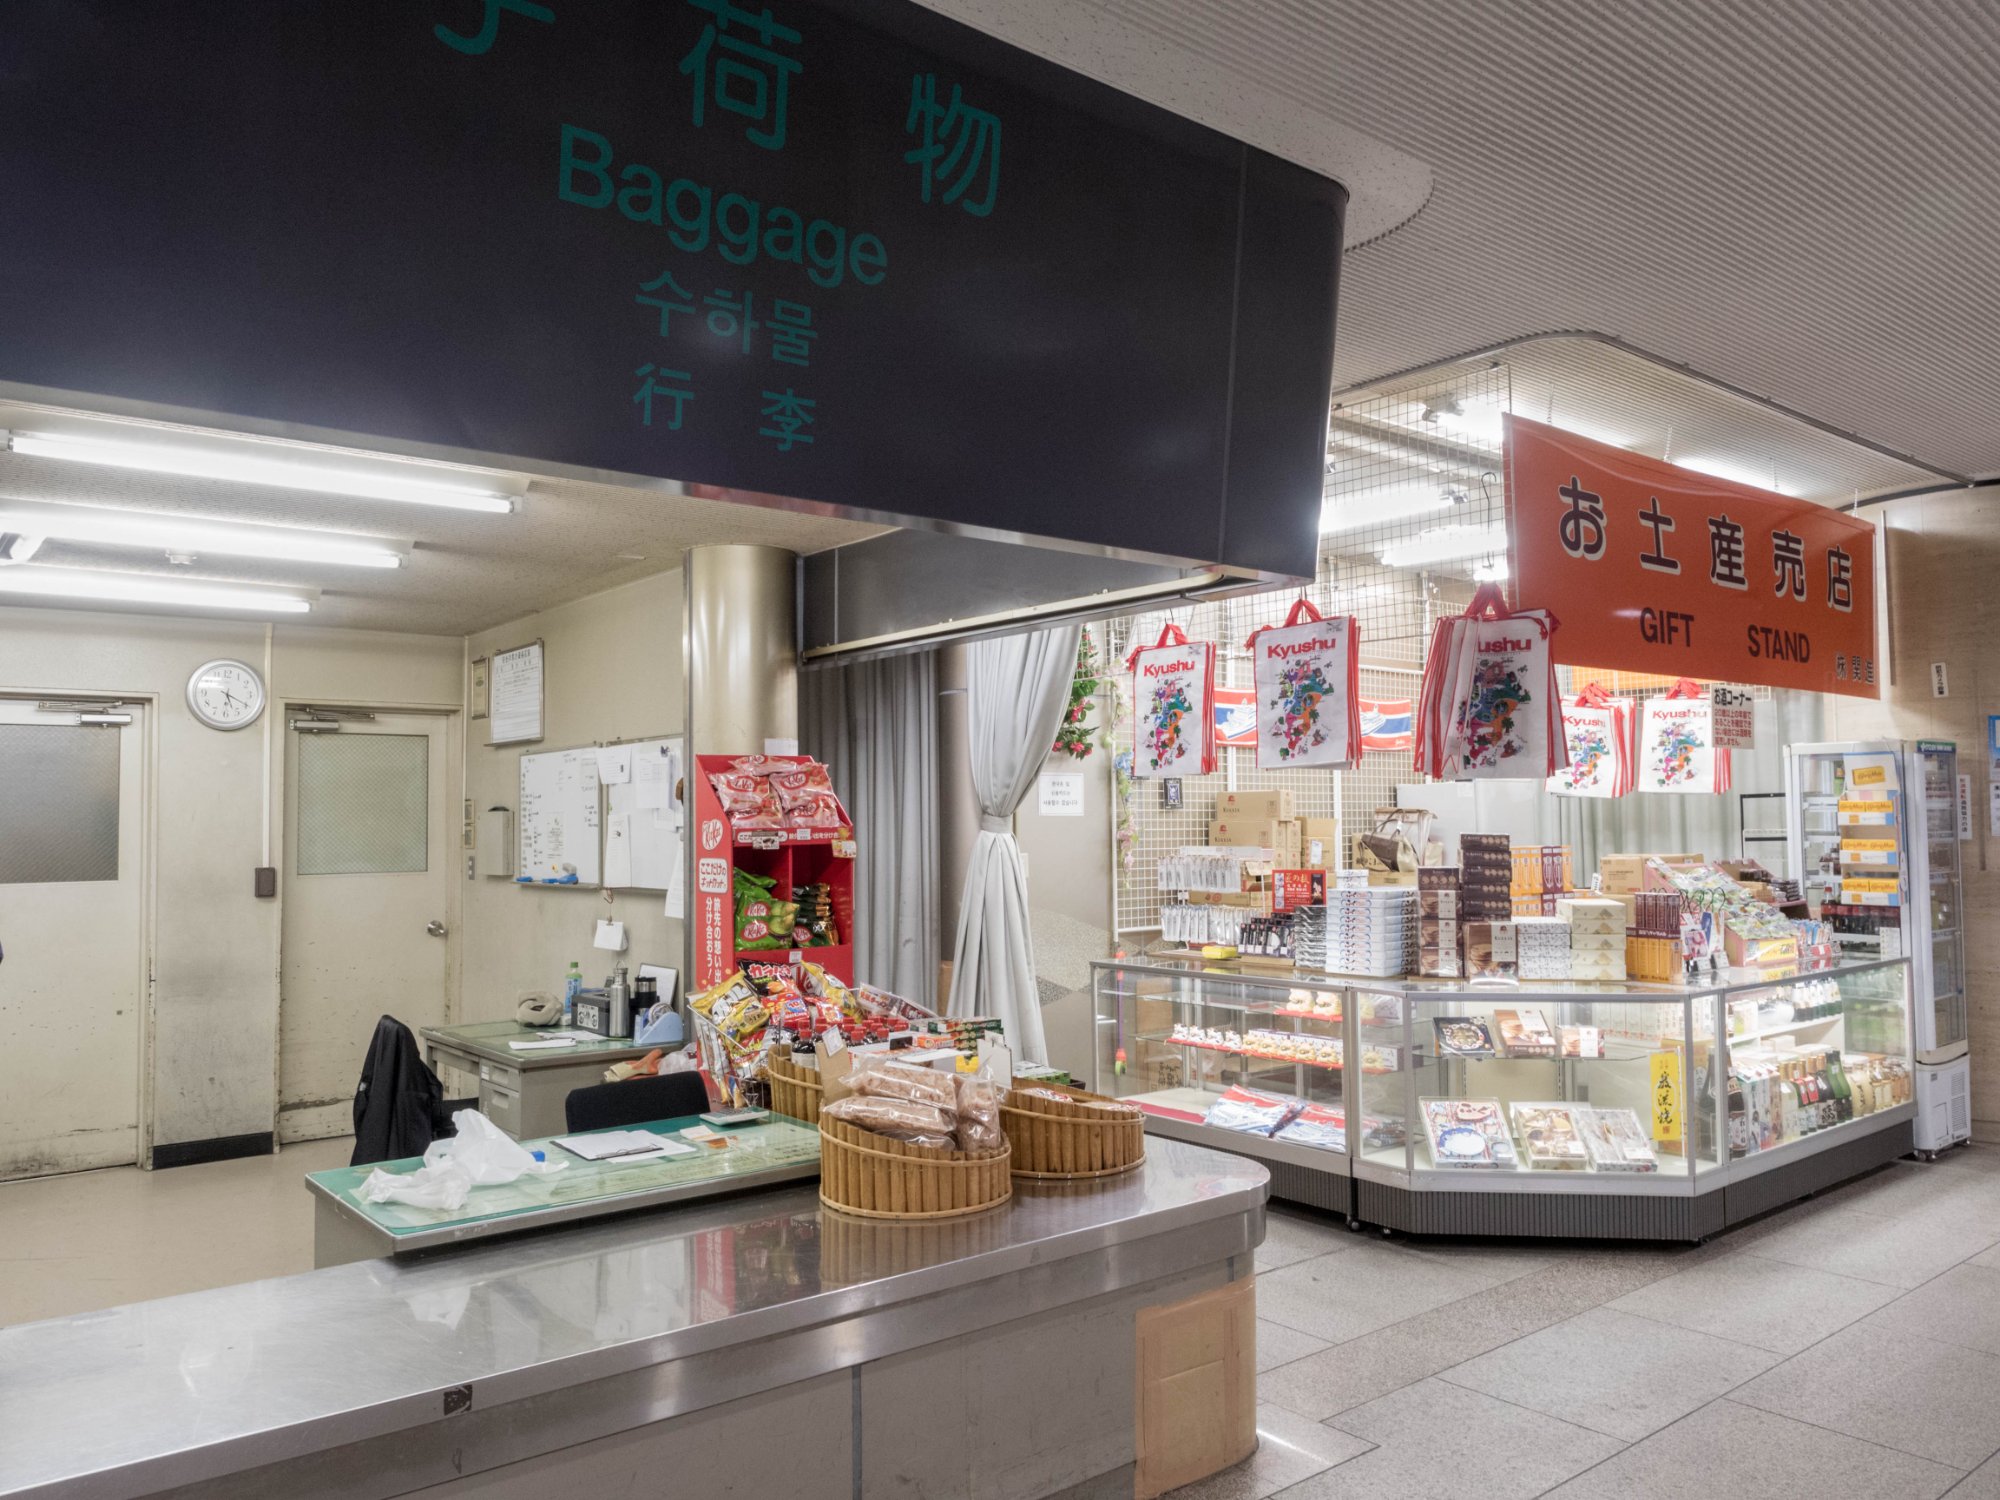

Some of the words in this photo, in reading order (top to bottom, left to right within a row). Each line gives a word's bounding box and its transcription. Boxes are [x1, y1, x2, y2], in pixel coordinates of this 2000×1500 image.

[557, 122, 889, 289] Baggage
[634, 269, 819, 367] 수하물
[632, 361, 818, 452] 行李
[1557, 474, 1854, 614] お土産売店
[1267, 637, 1336, 660] Kyushu
[1478, 636, 1532, 653] ushu
[1639, 606, 1695, 648] GIFT
[1747, 623, 1811, 664] STAND
[1143, 659, 1195, 679] Kyushu
[1652, 709, 1708, 720] Kyushu
[1714, 687, 1752, 707] お酒コーナー
